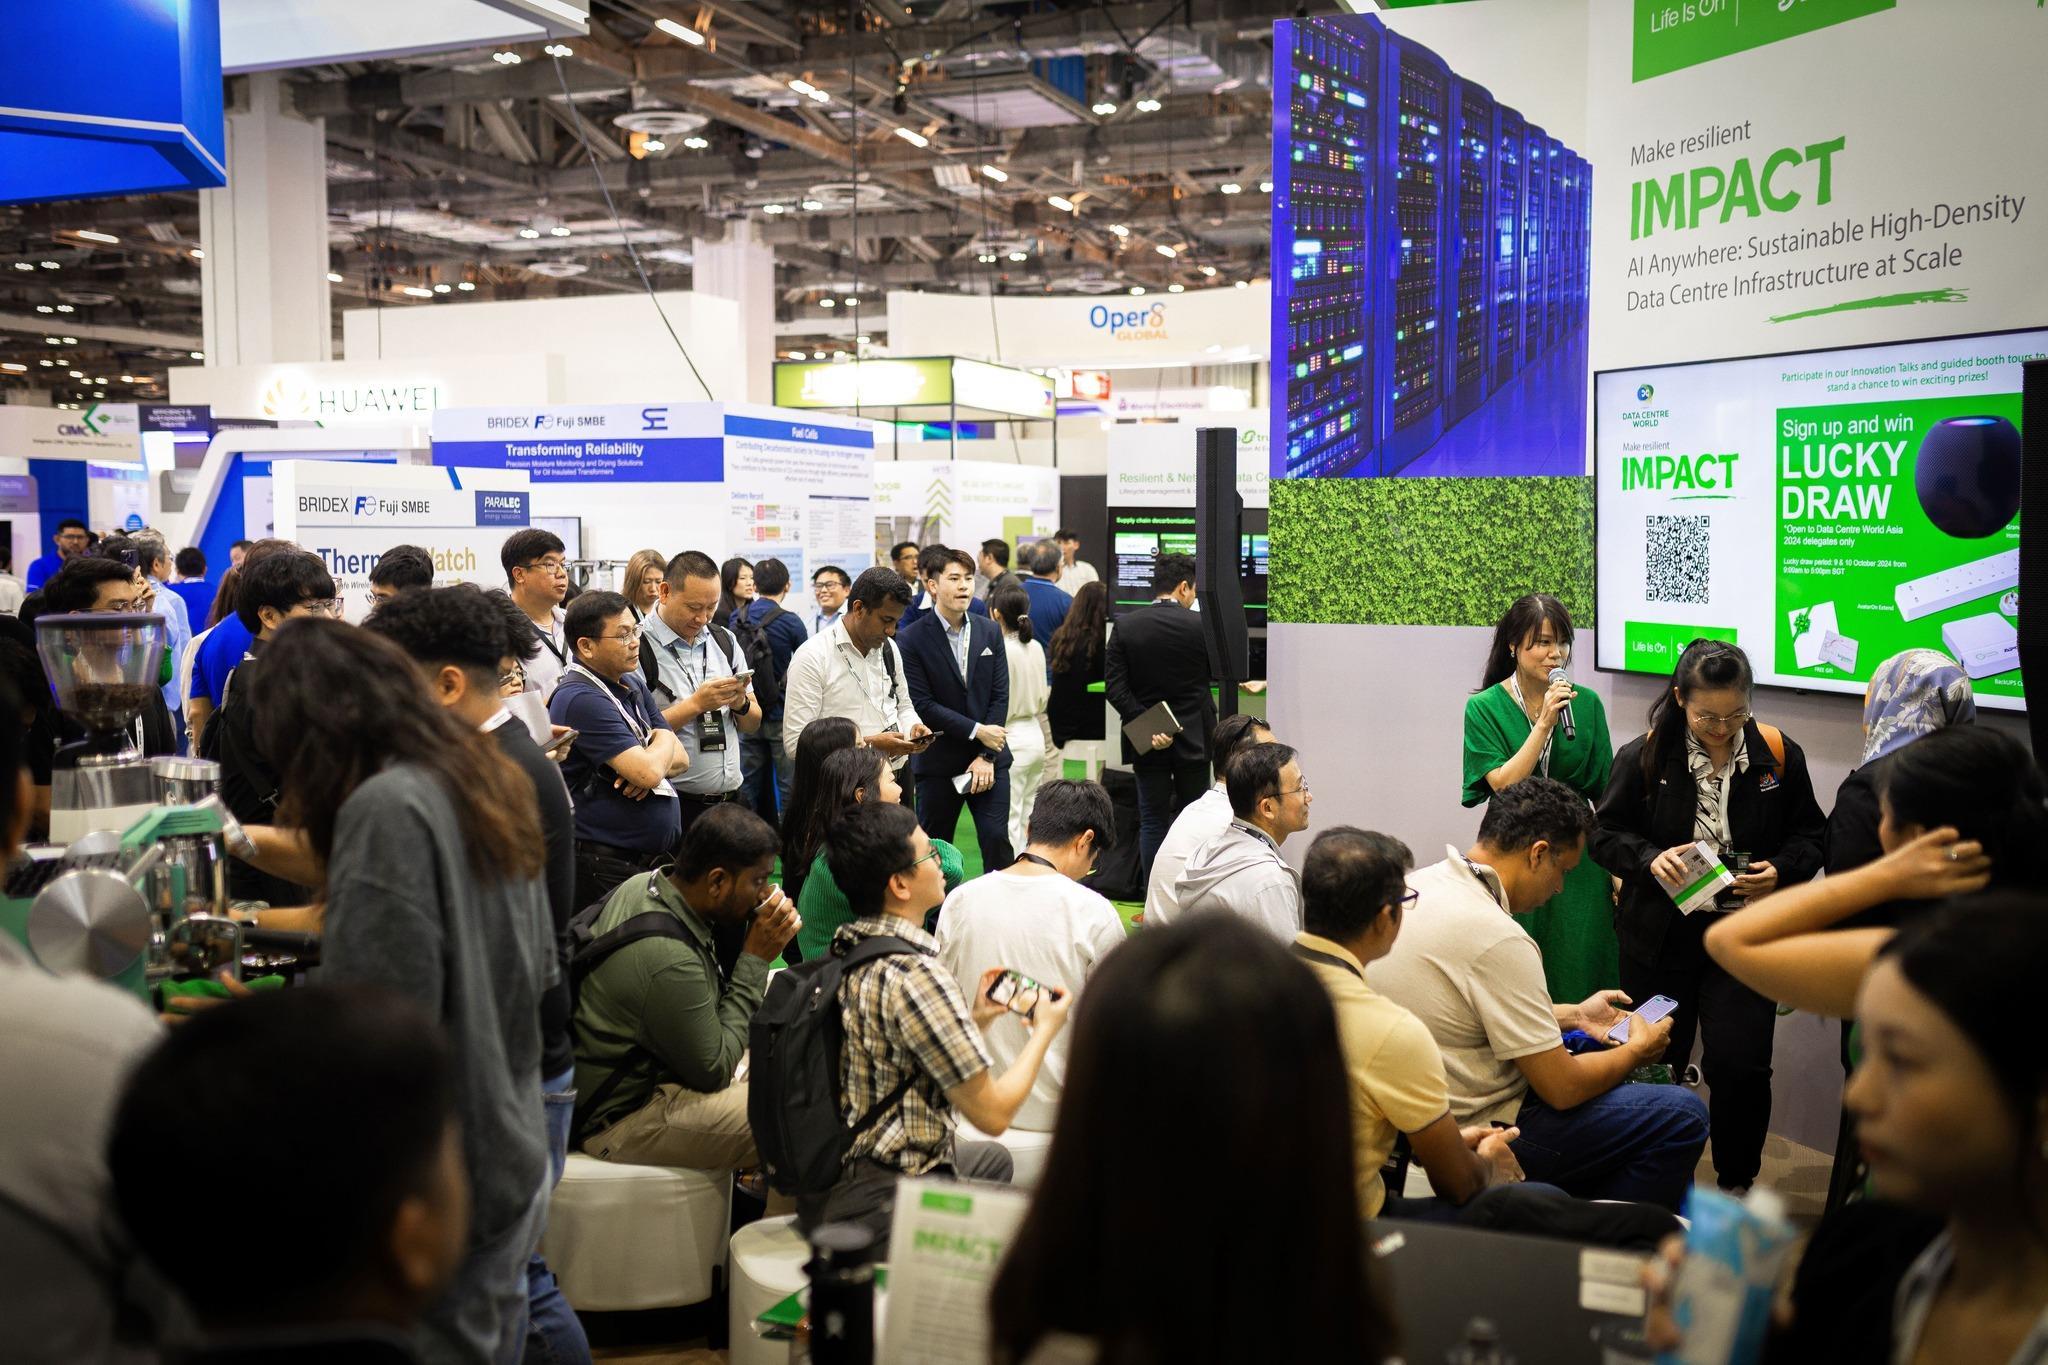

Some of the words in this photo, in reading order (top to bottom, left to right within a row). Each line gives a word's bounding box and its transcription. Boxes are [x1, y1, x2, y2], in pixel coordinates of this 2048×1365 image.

[1651, 6, 1679, 33] Life
[1682, 2, 1696, 23] Is
[1630, 139, 1675, 166] Make
[1680, 120, 1751, 155] resilient
[1630, 136, 1846, 241] IMPACT
[1627, 256, 1644, 278] AI
[1649, 245, 1742, 277] Anywhere:
[1747, 219, 1863, 258] Sustainable
[1871, 194, 2026, 242] High-Density
[1627, 289, 1665, 311] Data
[1670, 281, 1728, 305] Centre
[1734, 261, 1869, 296] Infrastructure
[1875, 254, 1896, 277] at
[1903, 242, 1962, 273] Scale
[1117, 330, 1169, 342] GLOBAL
[1781, 371, 1824, 383] Participate
[1824, 371, 1833, 379] in
[1835, 369, 1849, 379] our
[1851, 365, 1897, 377] Innovation
[1899, 362, 1919, 374] Talks
[1921, 361, 1938, 372] and
[1940, 358, 1973, 371] guided
[1976, 354, 2005, 367] booth
[2007, 354, 2033, 364] tours
[1827, 381, 1850, 392] stand
[1852, 383, 1857, 391] a
[1858, 379, 1889, 391] chance
[1891, 379, 1900, 388] to
[1902, 376, 1918, 386] win
[1920, 373, 1956, 387] exciting
[1958, 371, 1989, 385] prizes!
[319, 386, 438, 414] HUAWEI
[1622, 411, 1641, 420] DATA
[1641, 410, 1669, 419] CENTRE
[487, 416, 529, 429] BRIDEX
[556, 416, 575, 428] Fuji
[577, 415, 606, 427] SMBE
[1633, 419, 1658, 428] WORLD
[1783, 419, 1818, 441] Sign
[1823, 420, 1843, 440] up
[1848, 414, 1879, 434] and
[1884, 413, 1913, 432] win
[792, 427, 805, 439] Fuel
[805, 428, 819, 440] Cells
[506, 443, 583, 459] Transforming
[585, 442, 644, 458] Reliability
[1623, 442, 1640, 451] Make
[1642, 441, 1670, 451] resilient
[506, 460, 531, 468] Precision
[556, 459, 585, 468] Monitoring
[586, 459, 597, 467] and
[598, 459, 616, 469] Drying
[617, 459, 643, 467] Solutions
[1783, 440, 1908, 479] LUCKY
[533, 468, 541, 476] for
[551, 468, 577, 476] Insulated
[578, 467, 614, 476] Transformers
[1622, 453, 1739, 491] IMPACT
[1119, 473, 1163, 484] Resilient
[1166, 473, 1175, 483] &
[299, 496, 349, 513] BRIDEX
[380, 500, 399, 516] Fuji
[401, 500, 430, 514] SMBE
[484, 496, 521, 508] PARALEC
[1783, 484, 1892, 520] DRAW
[1116, 516, 1135, 525] Supply
[1136, 516, 1151, 524] chain
[2006, 523, 2020, 531] Gran
[1807, 525, 1815, 533] to
[1816, 524, 1834, 534] Data
[1835, 524, 1861, 534] Centre
[1862, 524, 1885, 534] World
[1885, 524, 1904, 534] Asia
[1783, 536, 1801, 545] 2024
[1803, 536, 1838, 548] delegates
[1839, 537, 1855, 548] only
[1784, 558, 1799, 566] Lucky
[1814, 558, 1832, 567] period:
[1853, 559, 1876, 567] October
[1632, 641, 1646, 652] Life
[1646, 642, 1654, 653] Is
[1654, 642, 1667, 654] On
